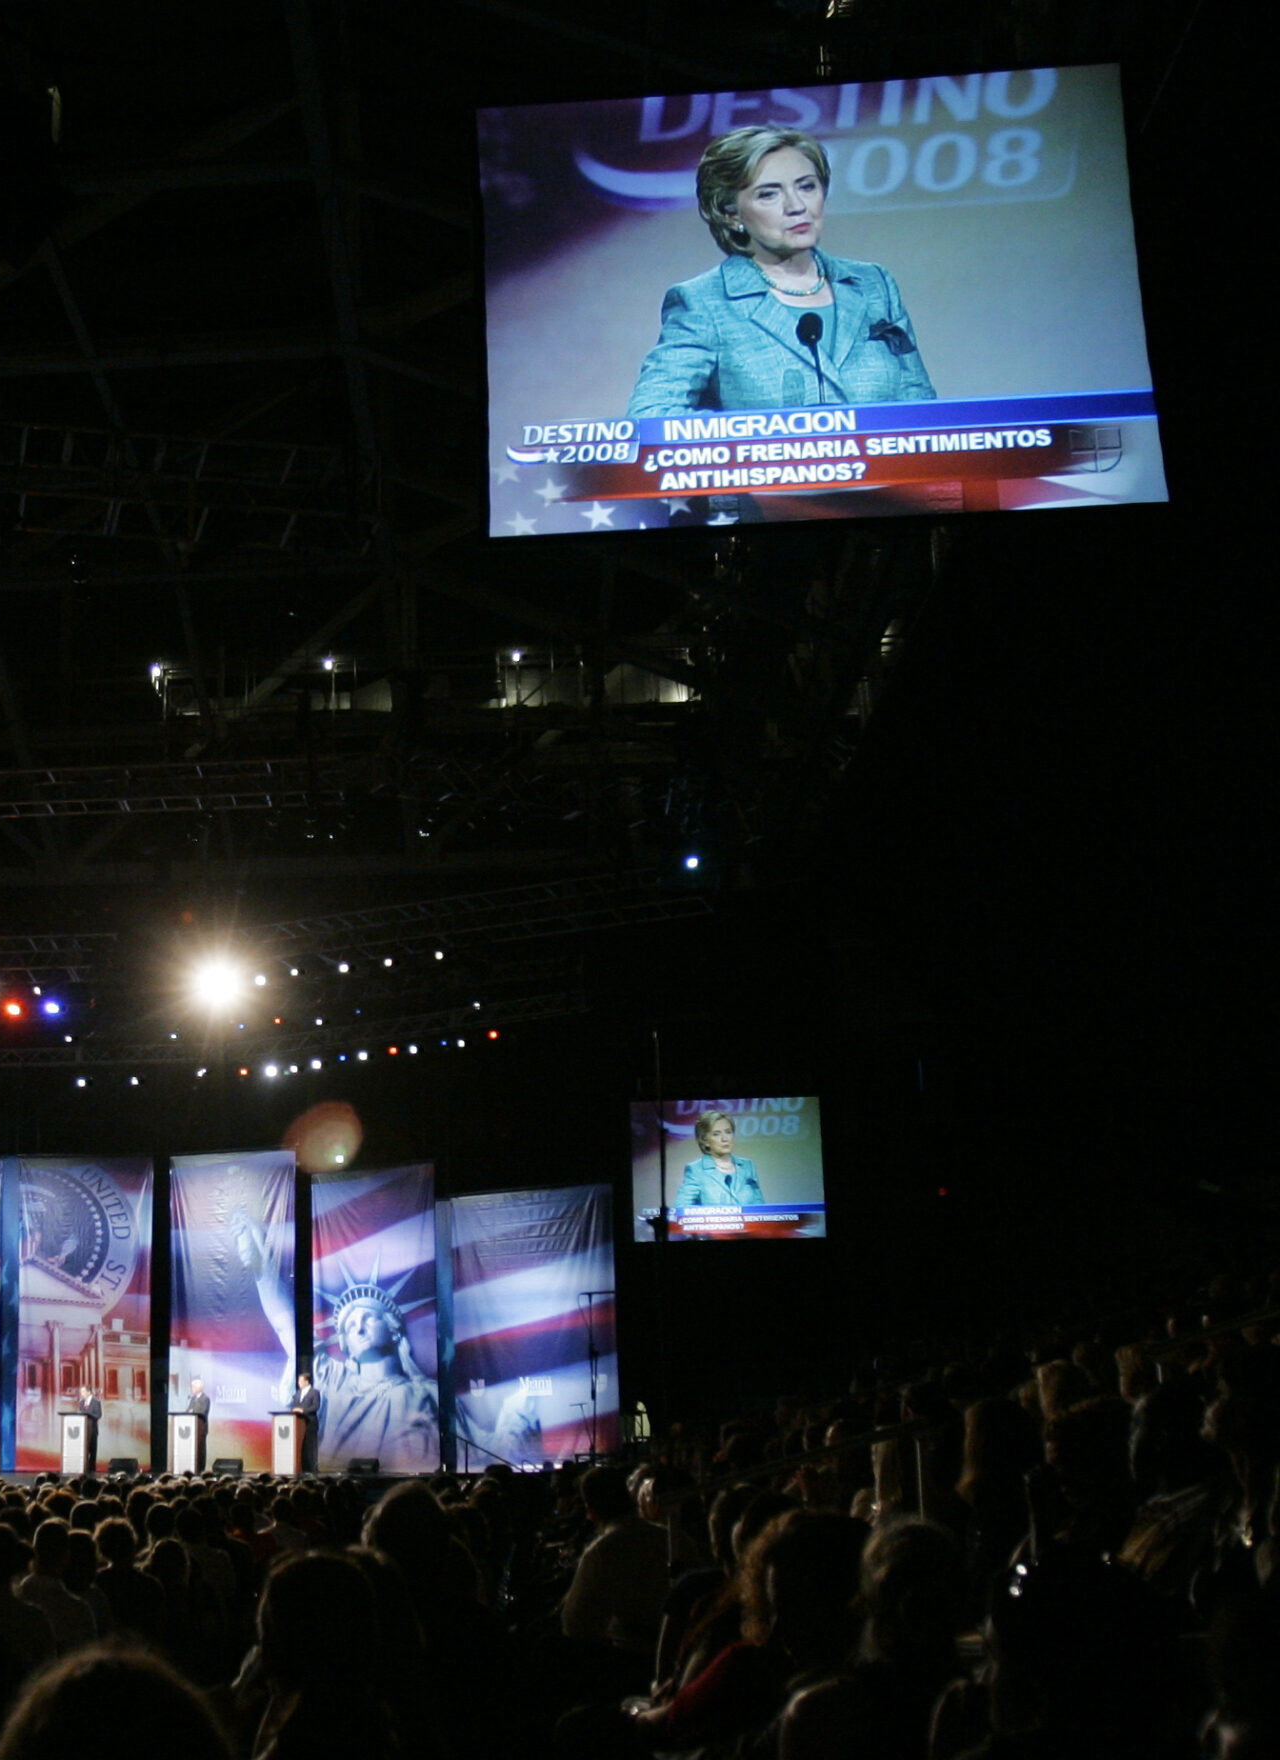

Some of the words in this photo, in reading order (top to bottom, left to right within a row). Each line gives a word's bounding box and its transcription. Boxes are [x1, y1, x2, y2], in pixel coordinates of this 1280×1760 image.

[847, 127, 1042, 196] 008
[523, 420, 635, 446] DESTINO
[560, 442, 630, 464] 2008
[644, 446, 730, 472] ¿COMO
[736, 438, 861, 463] FRENARIA
[866, 428, 1052, 456] SENTIMIENTOS
[659, 462, 867, 491] ANTIHISPANOS?
[739, 1115, 800, 1137] 008
[81, 1167, 131, 1240] UNITED
